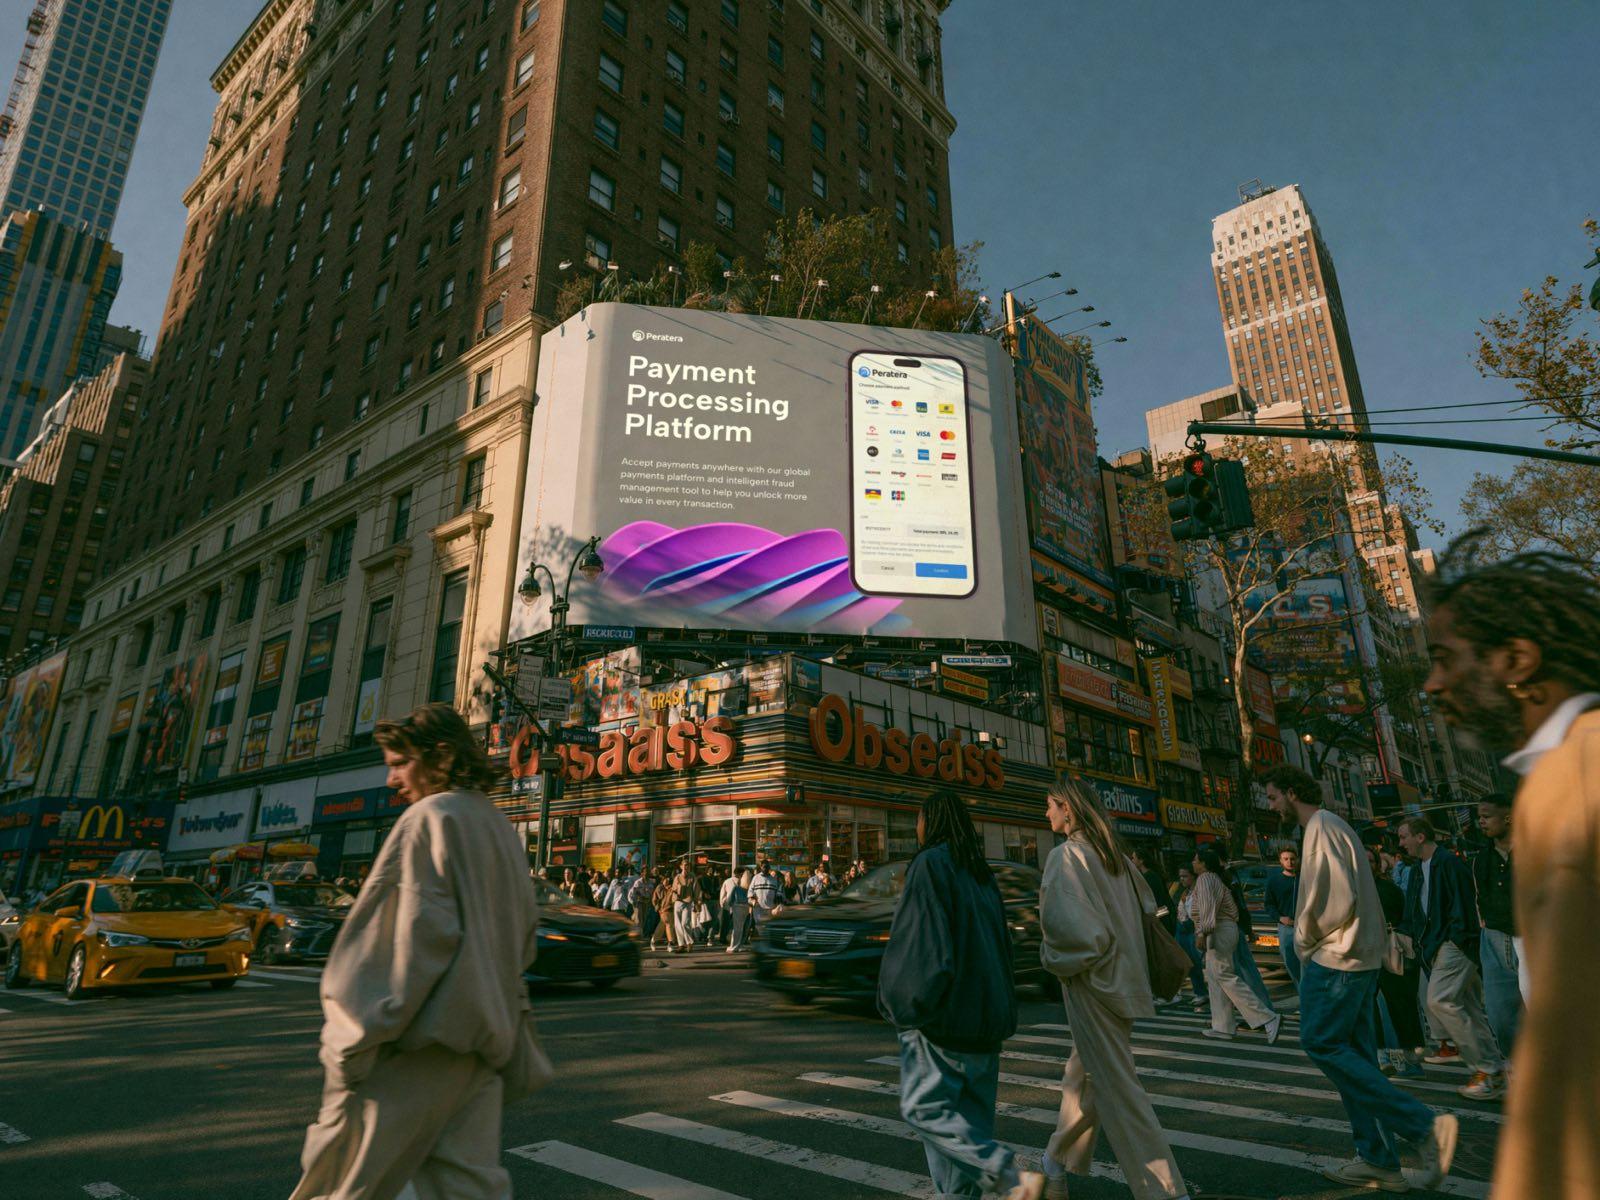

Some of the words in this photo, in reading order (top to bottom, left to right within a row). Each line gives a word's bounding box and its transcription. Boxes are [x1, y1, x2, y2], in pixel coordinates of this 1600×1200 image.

[646, 332, 684, 343] Peratera
[628, 355, 756, 385] Payment
[872, 369, 908, 379] Peratera
[627, 383, 789, 421] Processing
[624, 413, 752, 443] Platform
[621, 457, 654, 468] Accept
[656, 460, 700, 470] payments
[702, 463, 744, 473] anywhere
[746, 466, 765, 474] with
[784, 468, 811, 478] global
[620, 471, 664, 481] payments
[667, 473, 705, 483] platform
[707, 475, 723, 484] and
[726, 477, 769, 488] intelligent
[772, 479, 795, 488] fraud
[619, 484, 679, 495] management
[681, 486, 699, 494] tool
[713, 488, 732, 498] help
[735, 490, 751, 499] you
[753, 490, 782, 499] unlock
[784, 492, 808, 501] more
[618, 496, 643, 505] value
[645, 497, 654, 505] in
[656, 499, 681, 508] every
[683, 500, 736, 510] transaction.
